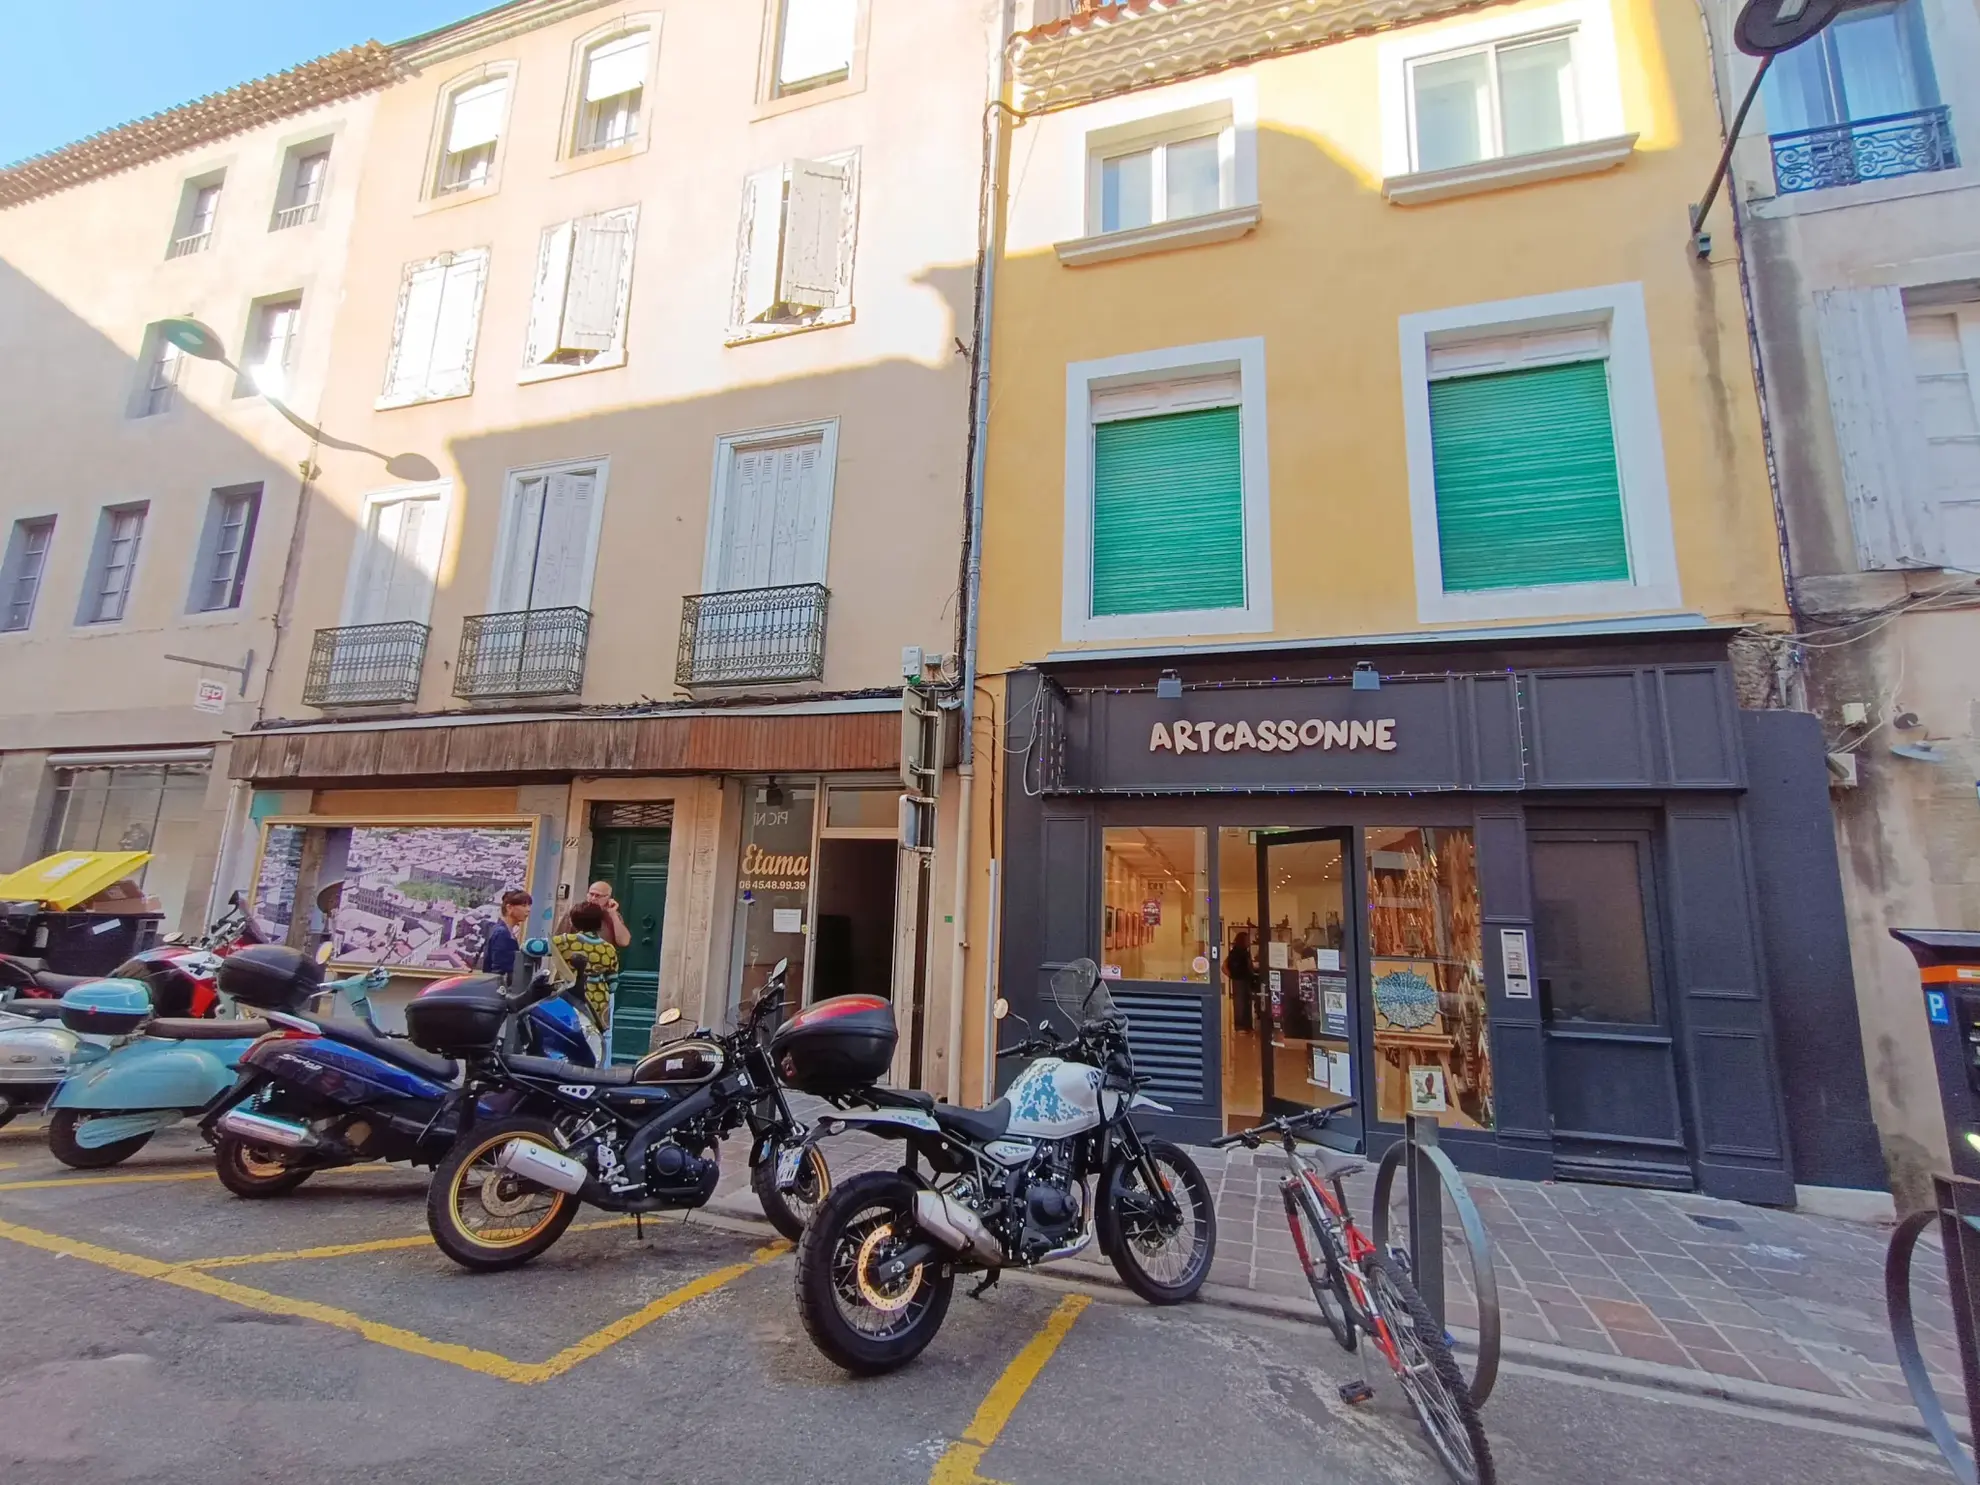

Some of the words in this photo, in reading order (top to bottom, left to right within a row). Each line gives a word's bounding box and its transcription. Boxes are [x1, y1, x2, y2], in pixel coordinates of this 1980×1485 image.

[1149, 718, 1398, 755] ARTCASSONNE
[742, 843, 809, 876] Etama
[1928, 993, 1944, 1017] P
